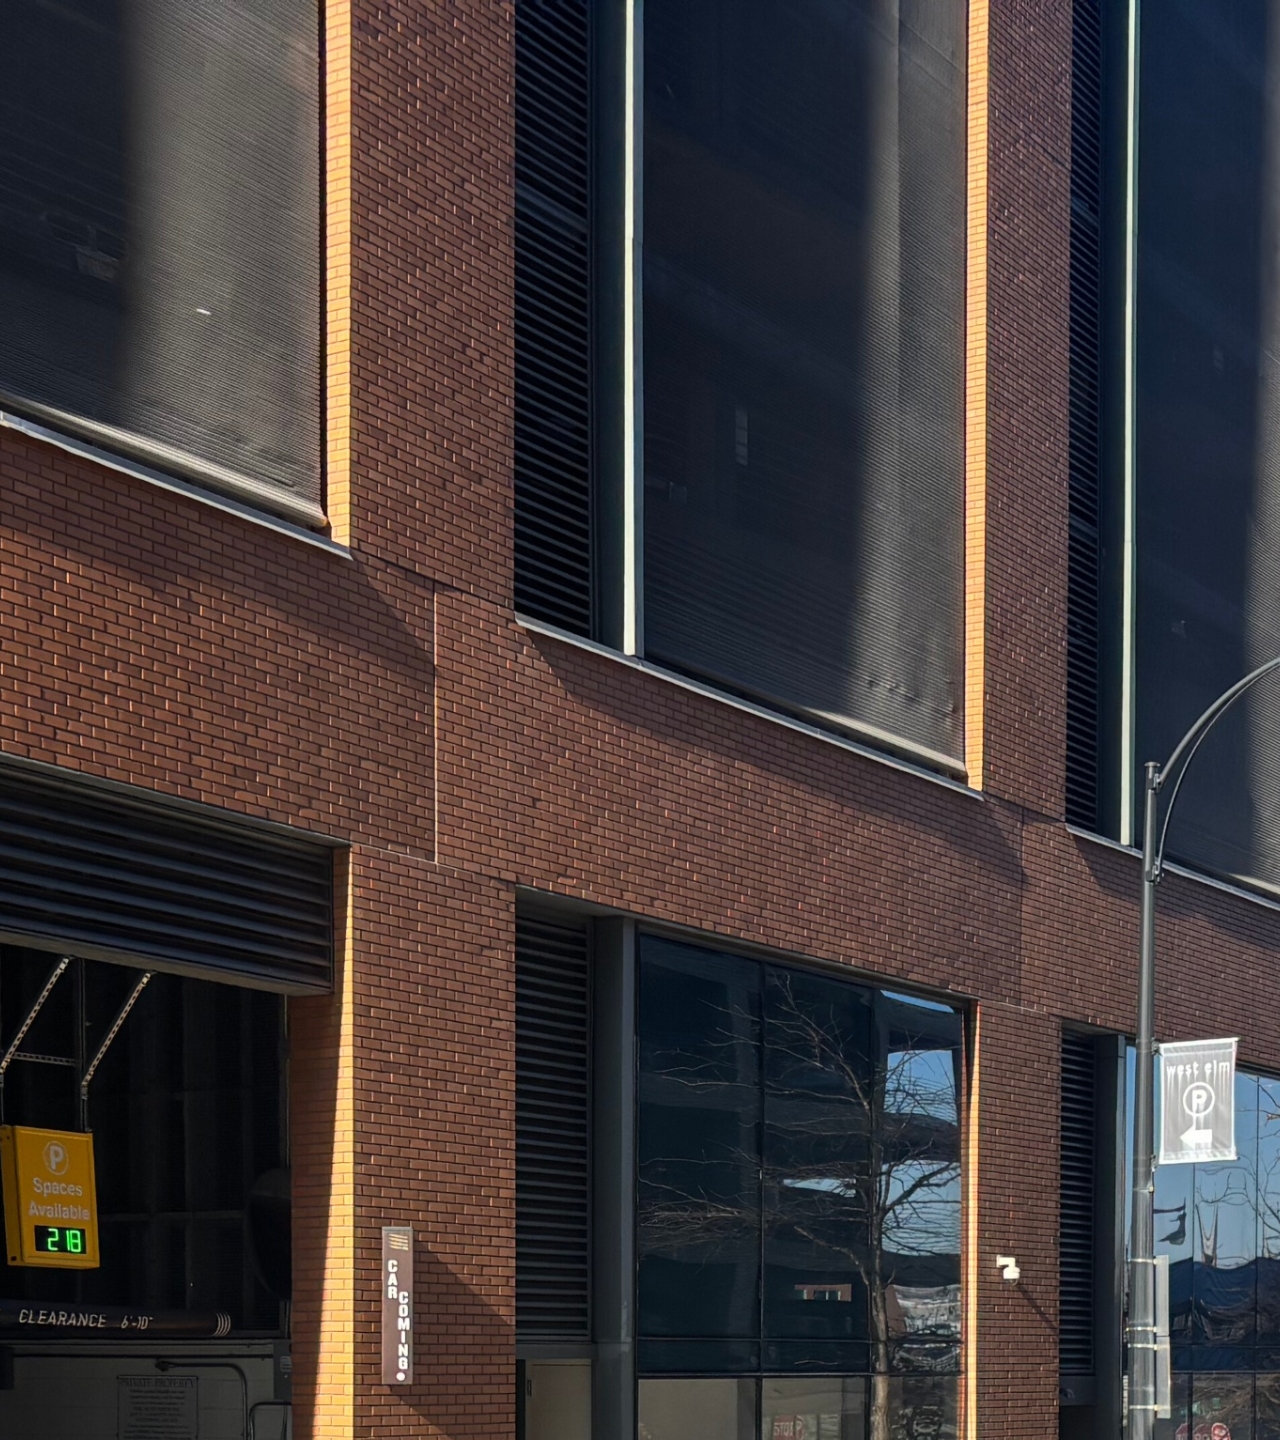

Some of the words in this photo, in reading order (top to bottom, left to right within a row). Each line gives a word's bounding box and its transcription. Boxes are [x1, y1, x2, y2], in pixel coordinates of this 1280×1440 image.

[1166, 1061, 1200, 1076] west
[1204, 1060, 1231, 1074] elm
[49, 1144, 64, 1171] P
[33, 1177, 83, 1197] Spaces
[28, 1200, 91, 1221] Available
[387, 1259, 398, 1299] CAR
[19, 1309, 107, 1328] CLEARANCE
[397, 1291, 411, 1370] COMING
